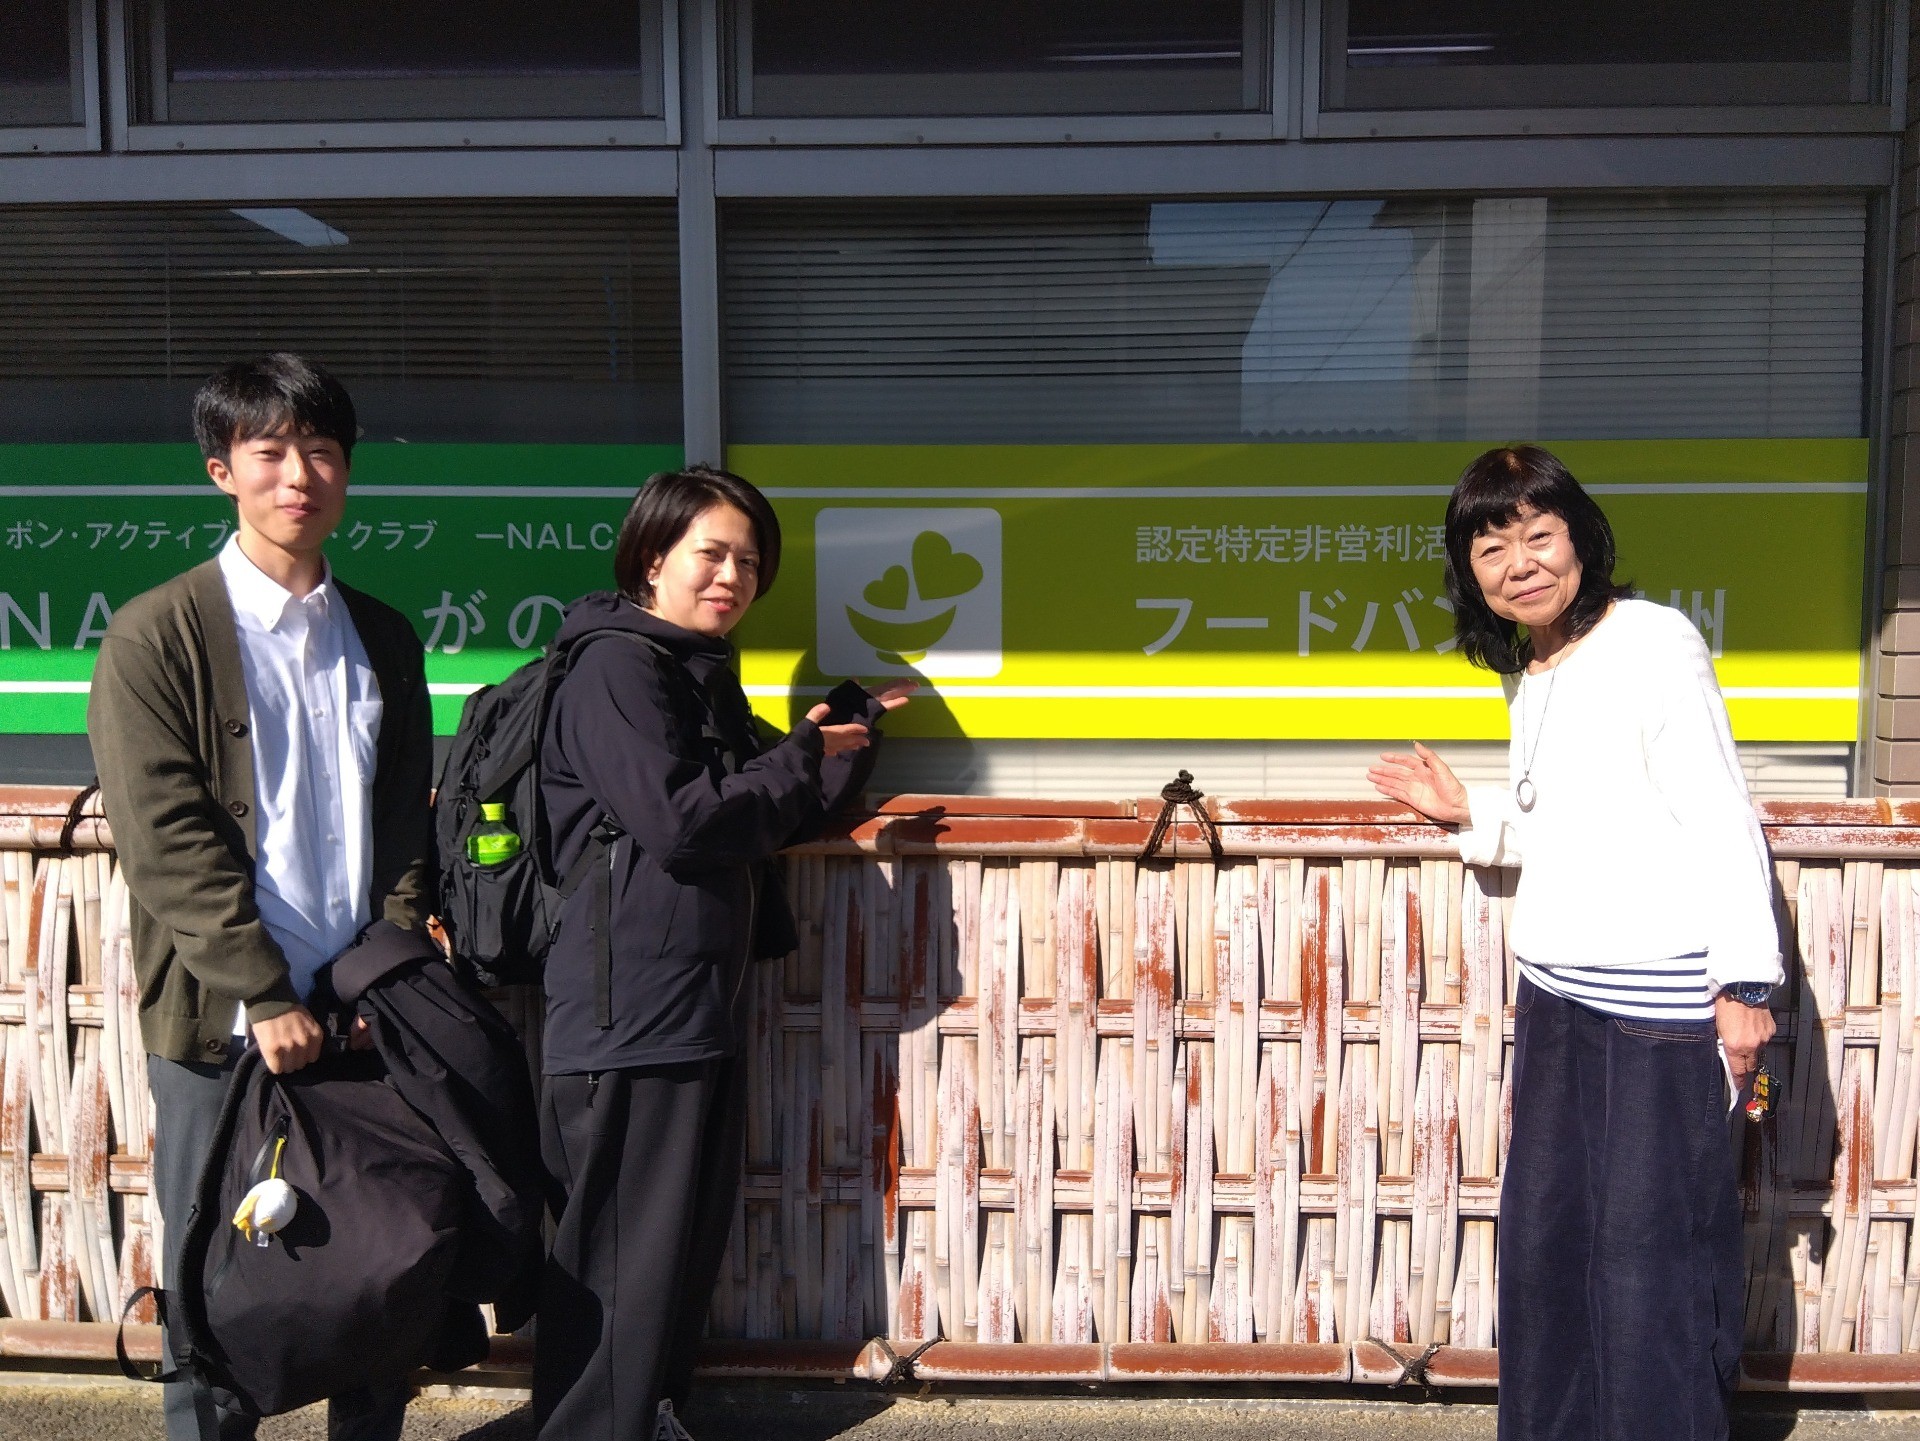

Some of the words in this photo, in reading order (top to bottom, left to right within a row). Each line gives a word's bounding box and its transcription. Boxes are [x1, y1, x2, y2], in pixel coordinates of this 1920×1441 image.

[1135, 523, 1447, 563] 認定特定非営利活
